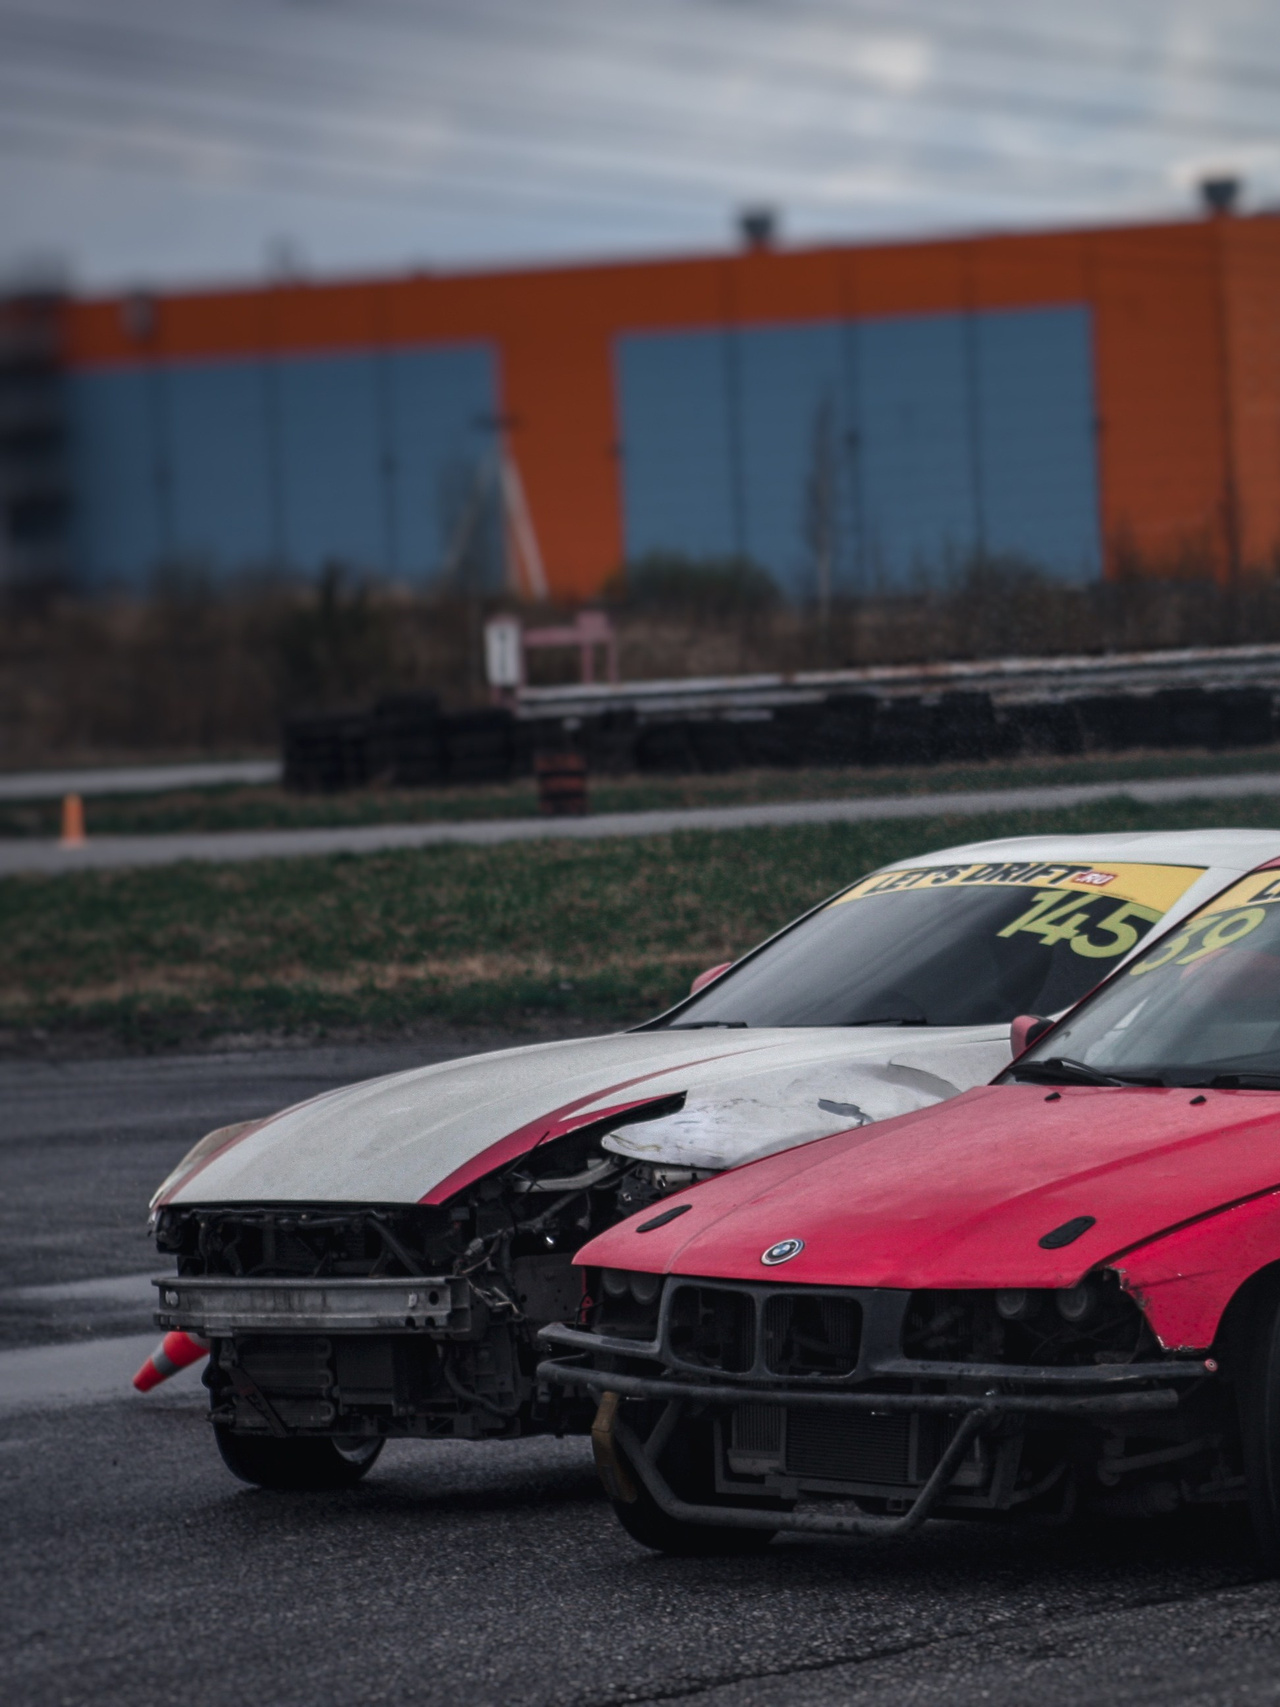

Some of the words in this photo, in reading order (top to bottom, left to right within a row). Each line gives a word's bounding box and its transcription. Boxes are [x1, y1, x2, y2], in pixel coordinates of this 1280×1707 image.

[861, 864, 971, 898] LET'S
[960, 862, 1093, 886] DRIFT
[996, 890, 1166, 958] 145
[1129, 908, 1266, 976] 39
